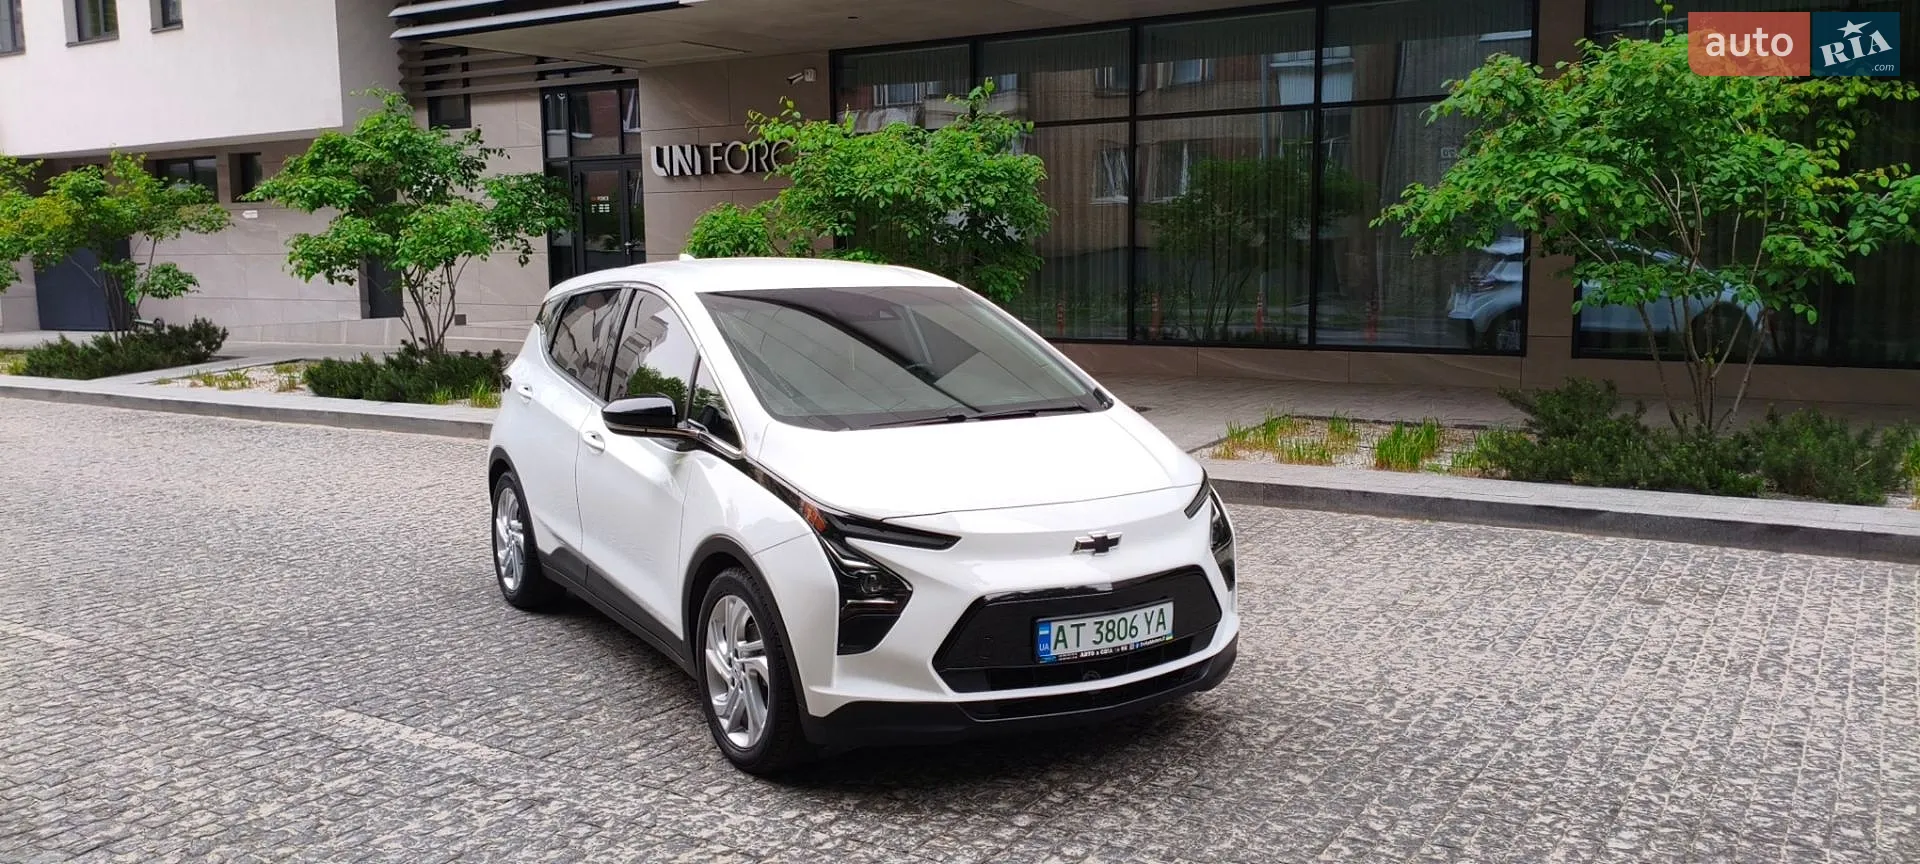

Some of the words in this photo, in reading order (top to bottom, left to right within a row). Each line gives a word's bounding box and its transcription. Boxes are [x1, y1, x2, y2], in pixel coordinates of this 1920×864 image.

[651, 144, 701, 176] UNI
[710, 140, 811, 174] FORC
[1053, 623, 1087, 650] AT
[1092, 614, 1139, 645] 3806
[1144, 607, 1167, 635] YA
[1039, 643, 1050, 652] UA
